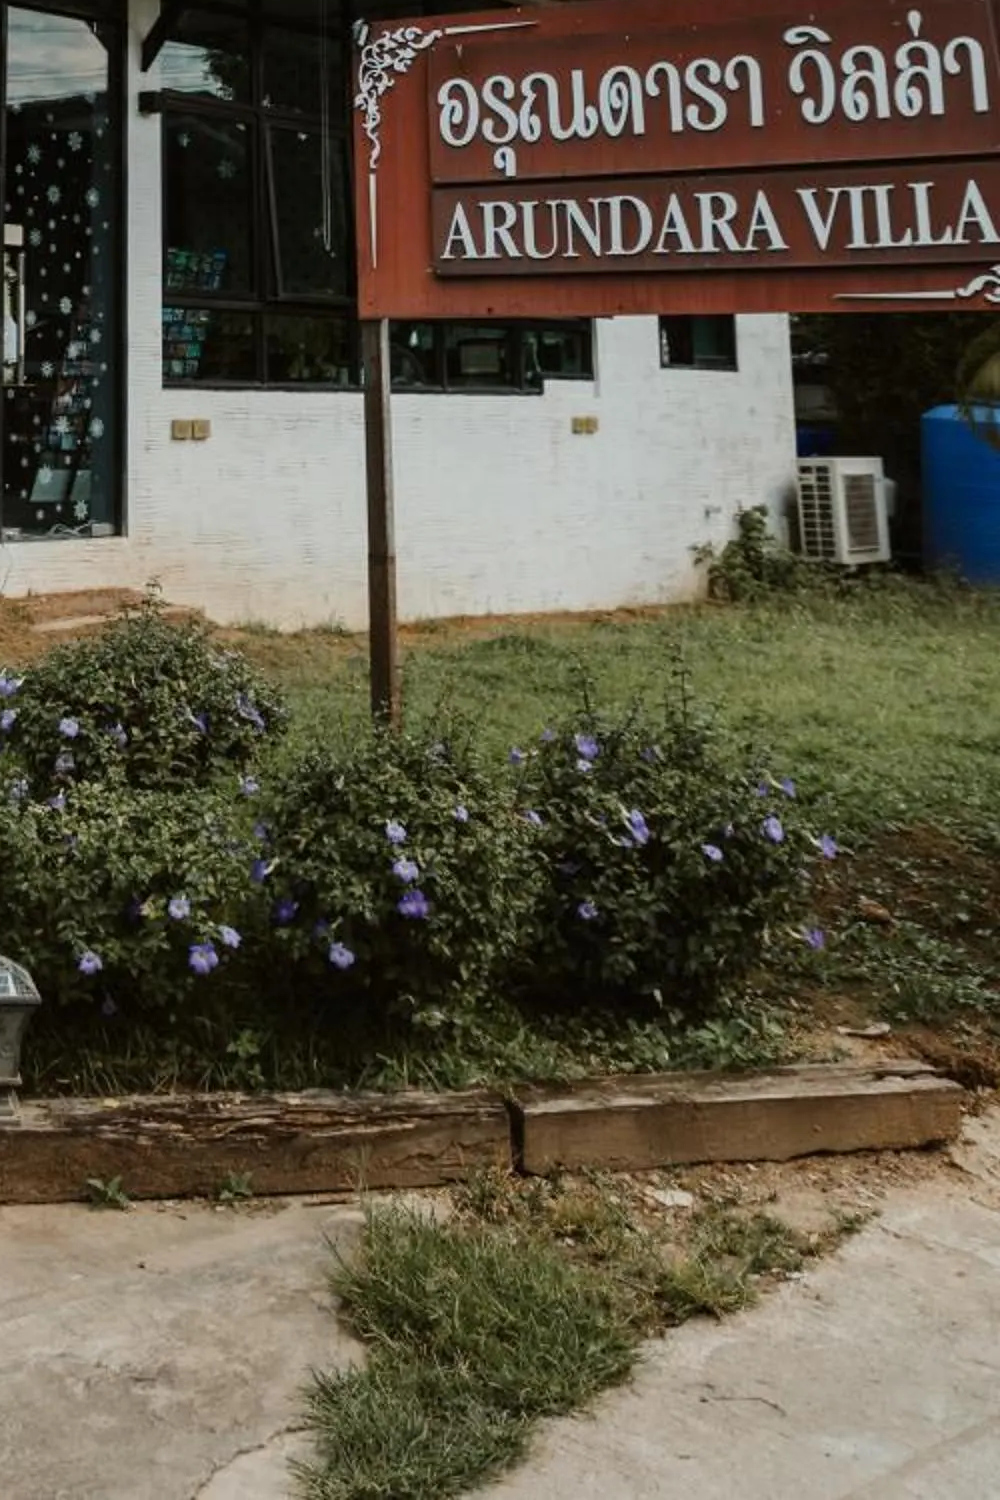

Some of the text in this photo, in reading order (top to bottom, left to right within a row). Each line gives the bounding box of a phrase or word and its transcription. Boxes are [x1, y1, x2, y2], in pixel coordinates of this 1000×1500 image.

[437, 9, 989, 177] อรุณดารา วิลล่า
[440, 179, 1000, 260] ARUNDARA VILLA
